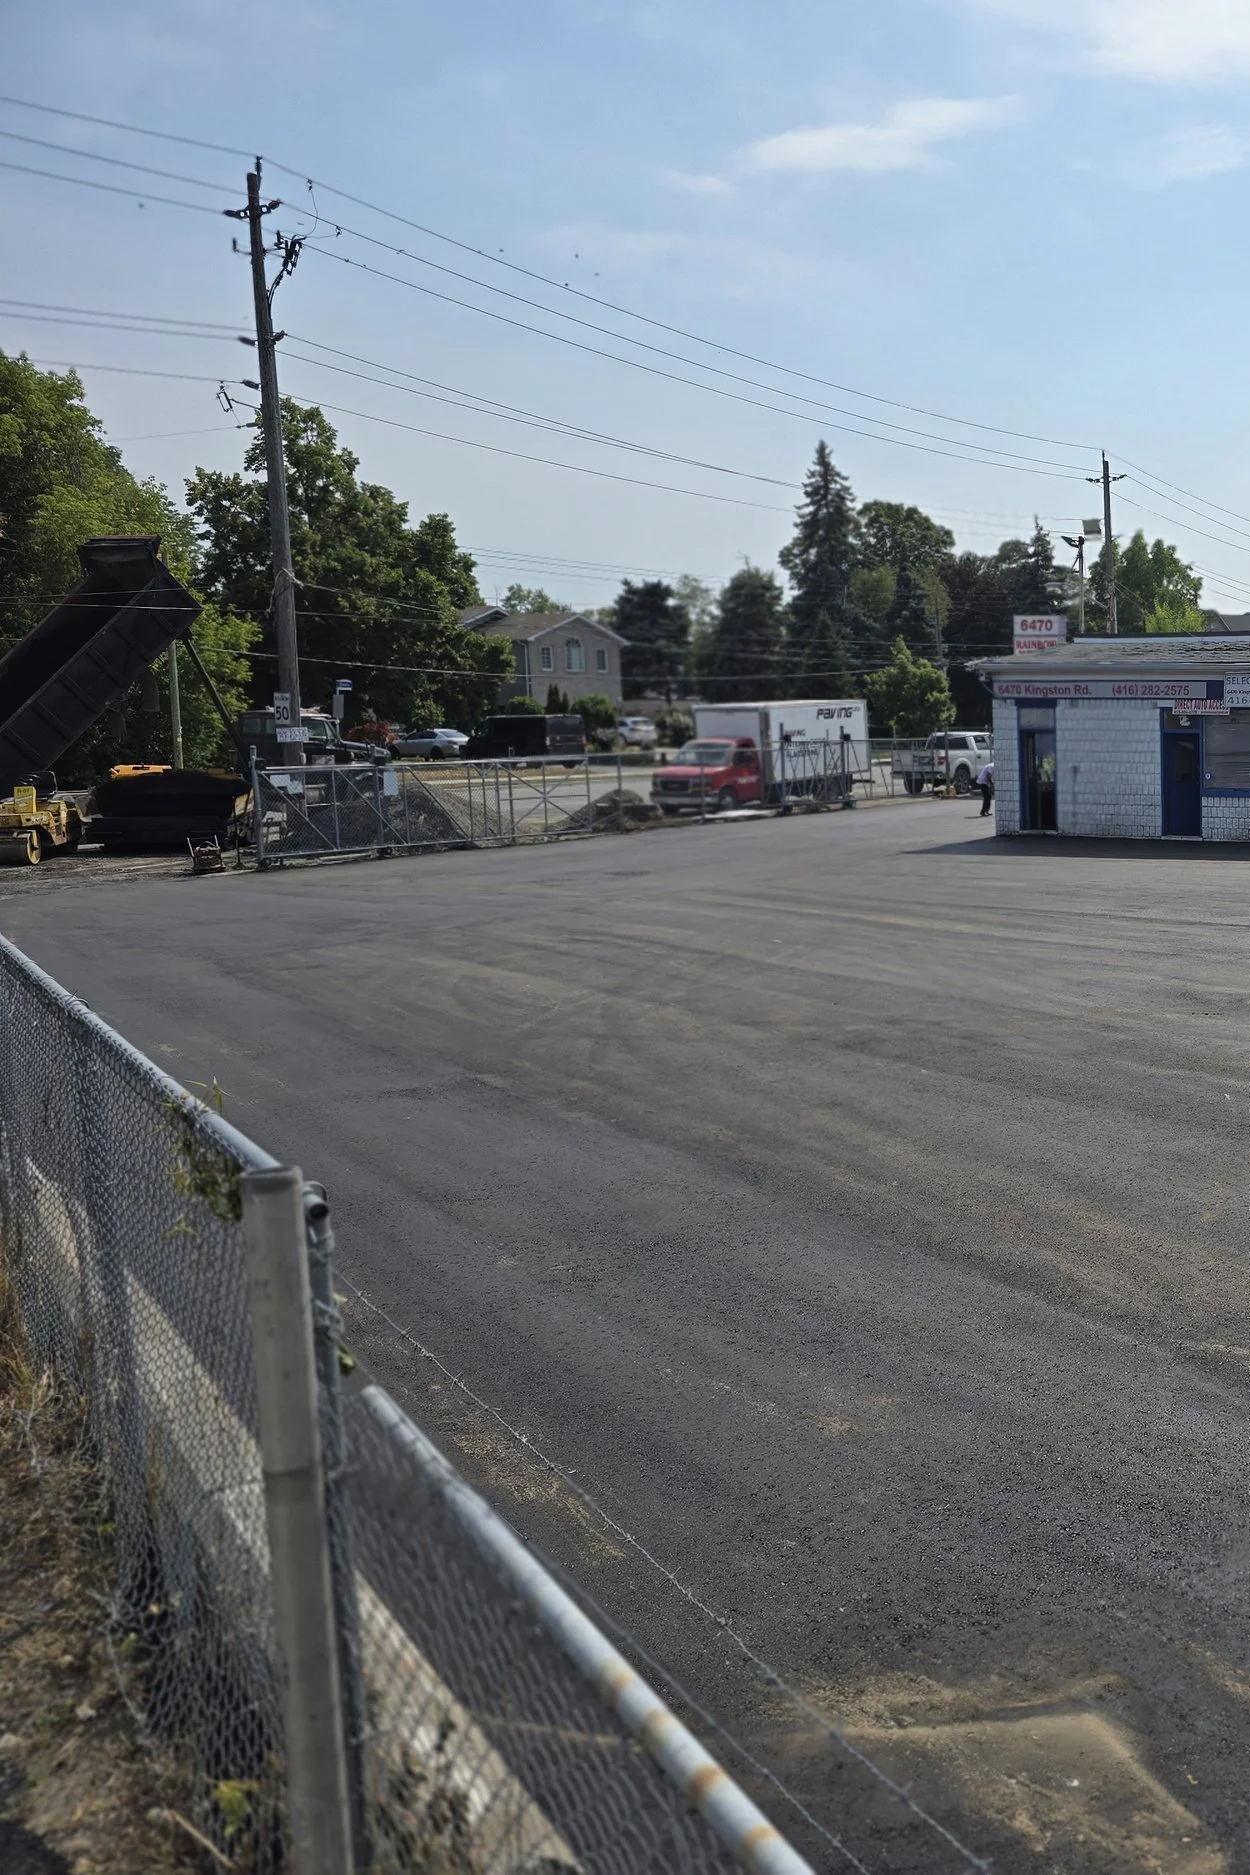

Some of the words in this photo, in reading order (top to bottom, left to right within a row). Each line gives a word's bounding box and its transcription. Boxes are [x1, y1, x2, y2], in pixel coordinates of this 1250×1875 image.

[1020, 619, 1054, 632] 6470
[998, 683, 1021, 695] 6470
[1024, 684, 1072, 697] Kingston
[1074, 684, 1092, 695] Rd.
[1112, 684, 1138, 696] (416)
[1141, 685, 1190, 696] 282-2575
[1194, 699, 1207, 710] AUTO
[275, 706, 289, 721] 50
